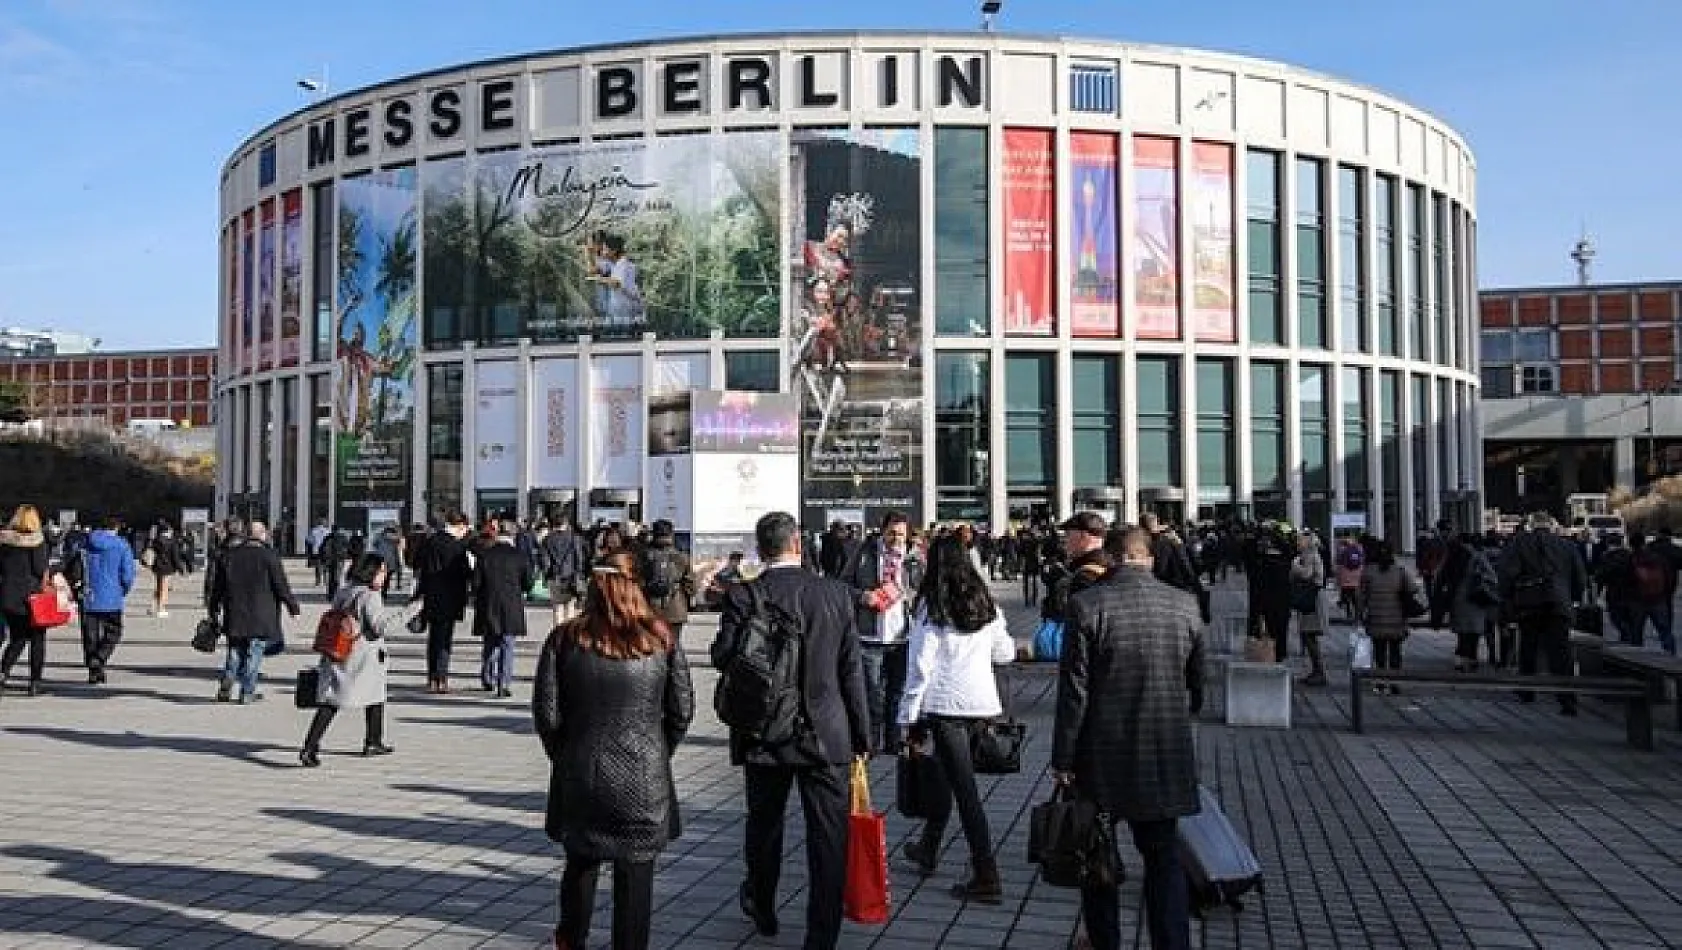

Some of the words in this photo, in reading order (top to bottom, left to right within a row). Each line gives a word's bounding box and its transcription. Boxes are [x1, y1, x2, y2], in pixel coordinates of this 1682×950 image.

[307, 80, 515, 169] MESSE
[597, 54, 986, 117] BERLIN
[501, 162, 659, 238] Malaysia
